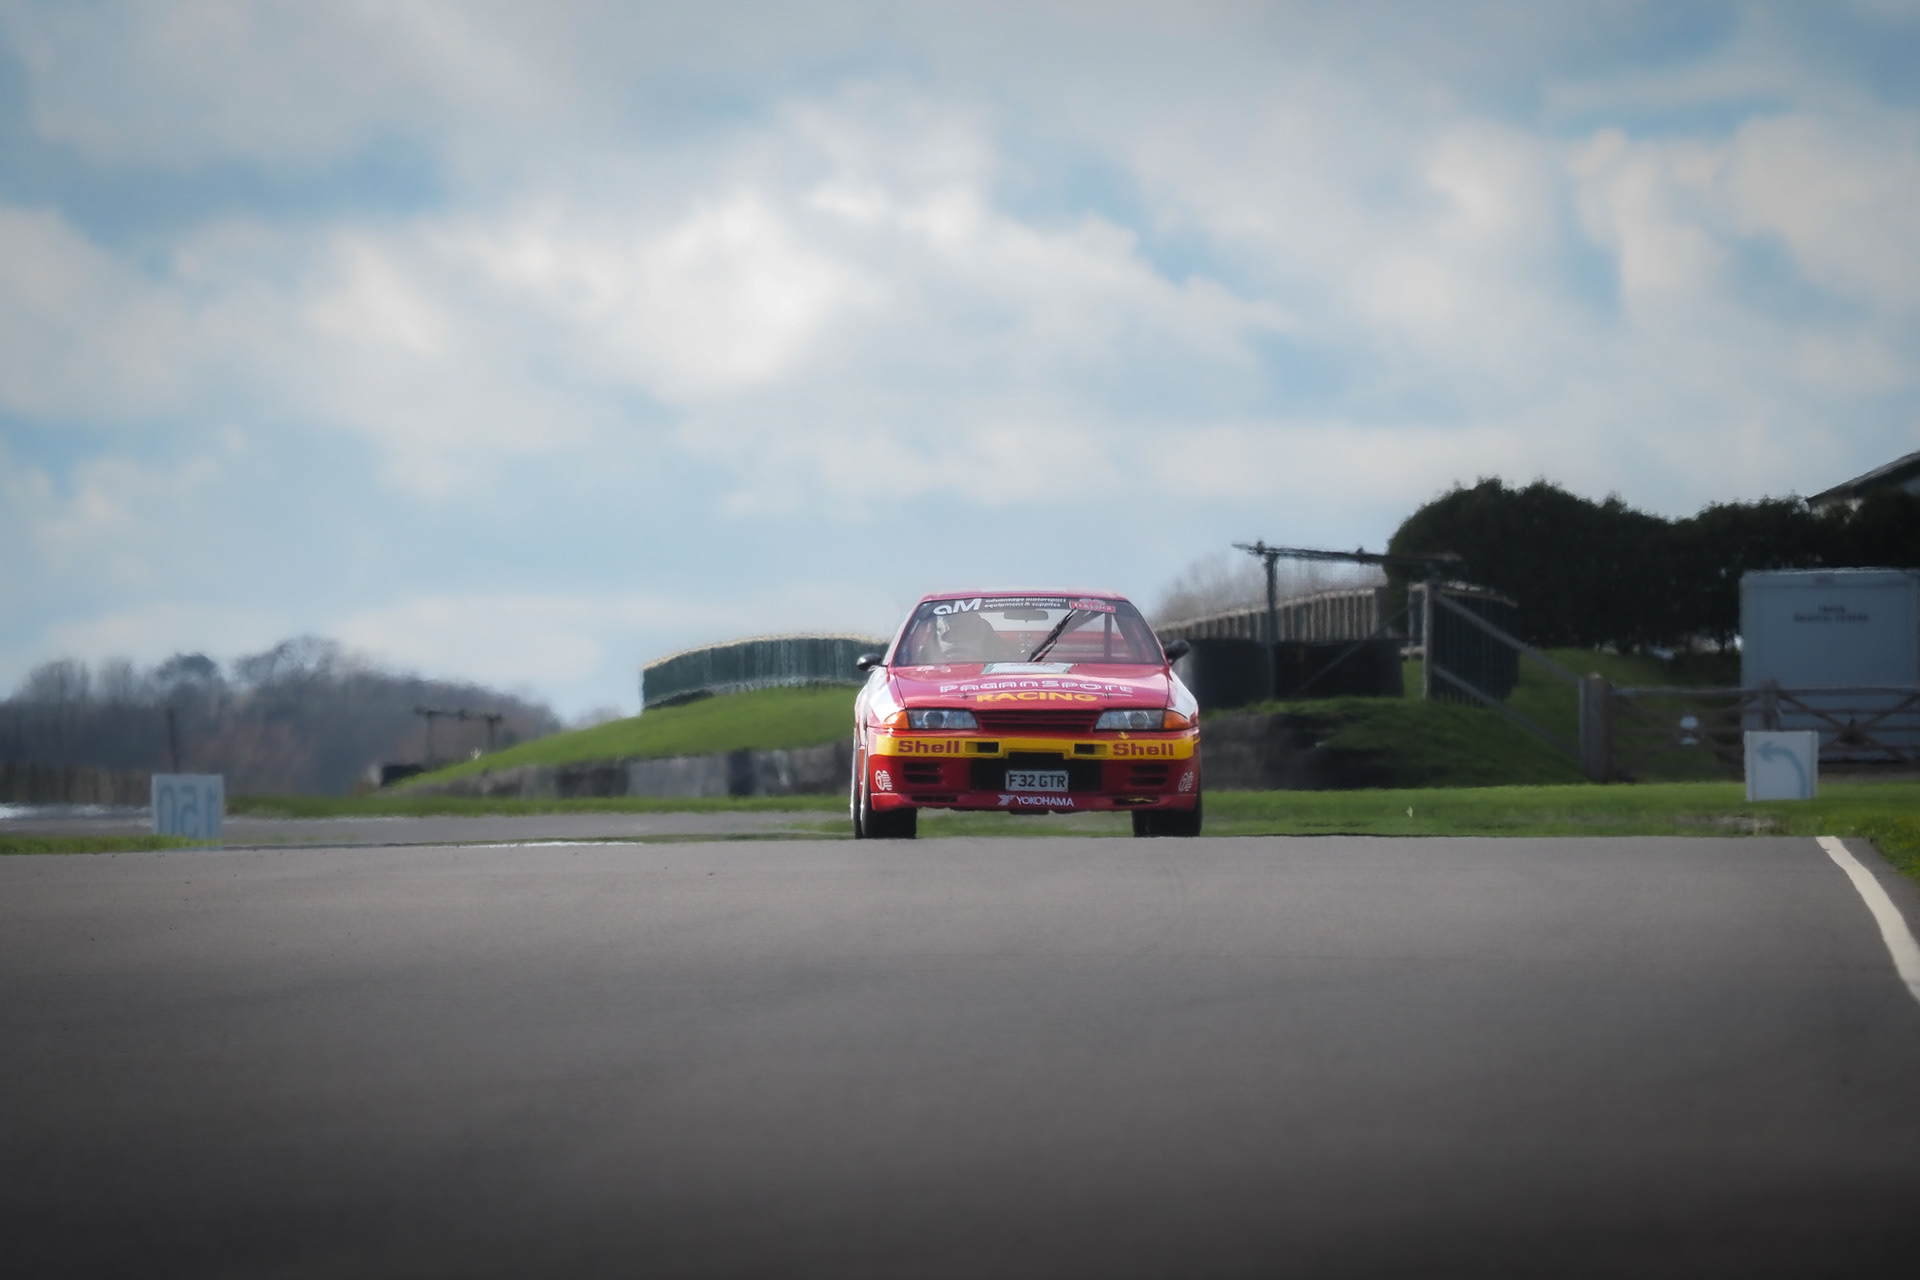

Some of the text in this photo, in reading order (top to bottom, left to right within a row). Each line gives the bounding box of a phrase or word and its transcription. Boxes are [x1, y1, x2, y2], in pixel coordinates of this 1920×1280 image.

[976, 692, 1097, 703] RACING
[898, 740, 959, 753] Shell
[1113, 743, 1174, 756] Shell
[1008, 774, 1066, 788] F32 GTR
[1016, 796, 1074, 807] YOKOHAMA
